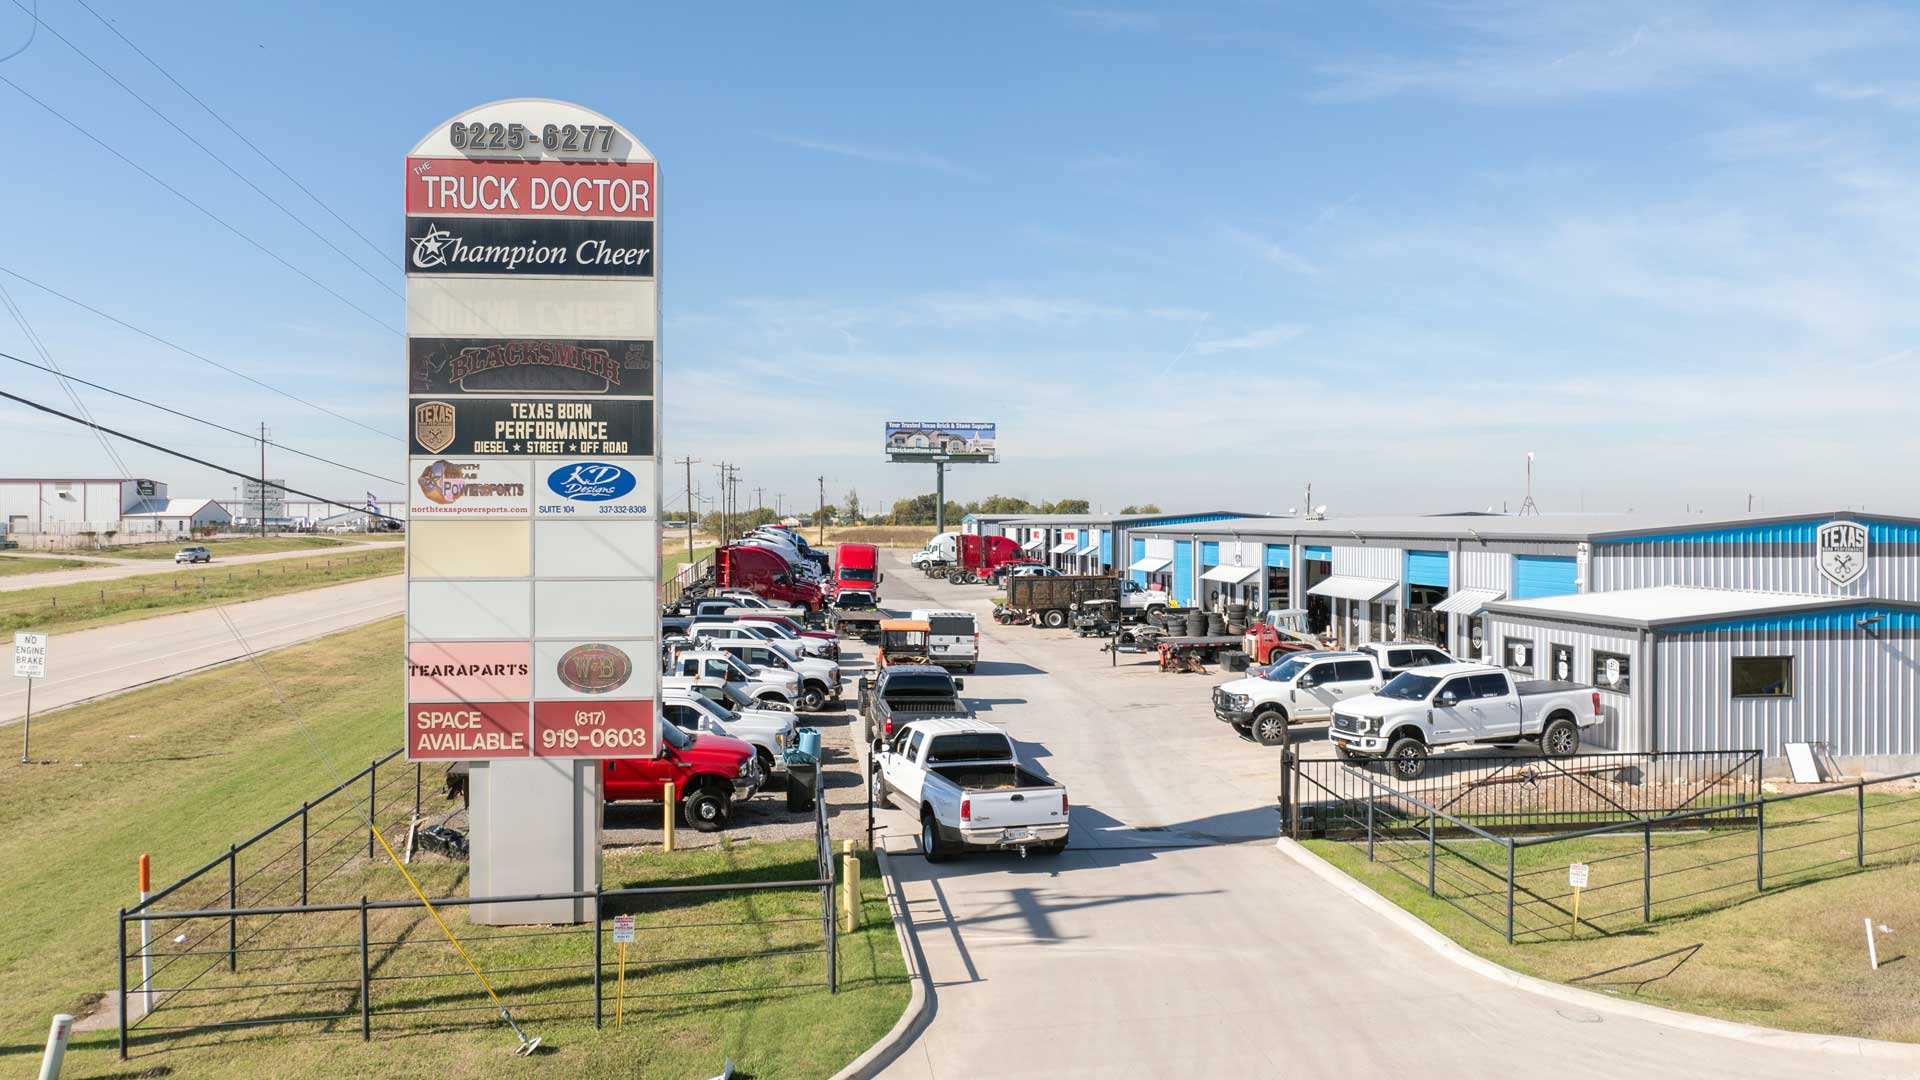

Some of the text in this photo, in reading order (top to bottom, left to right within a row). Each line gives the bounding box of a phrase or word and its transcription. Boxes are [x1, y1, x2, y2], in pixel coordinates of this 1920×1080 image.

[451, 121, 616, 152] 6225-6277
[413, 160, 432, 175] THE
[421, 175, 650, 213] TRUCK DOCTOR
[411, 230, 649, 270] Champion Cheer
[449, 341, 621, 385] BLACKSMITH
[418, 405, 453, 423] TEXAS
[511, 403, 592, 420] TEXAS BORN
[495, 421, 608, 440] PERFORMANCE
[474, 441, 628, 454] DIESEL STREET OFF ROAD
[565, 484, 615, 496] Designs
[411, 506, 528, 515] northtexaspowersports.com
[538, 505, 575, 514] SUITE 104
[1822, 525, 1864, 548] TEXAS
[24, 636, 37, 645] NO
[15, 645, 45, 656] ENGINE
[16, 656, 43, 666] BRAKE
[409, 664, 528, 677] TEARAPARTS
[417, 712, 481, 730] SPACE
[575, 710, 606, 727] (817)
[417, 733, 524, 751] AVAILABLE
[542, 729, 646, 749] 919-0603
